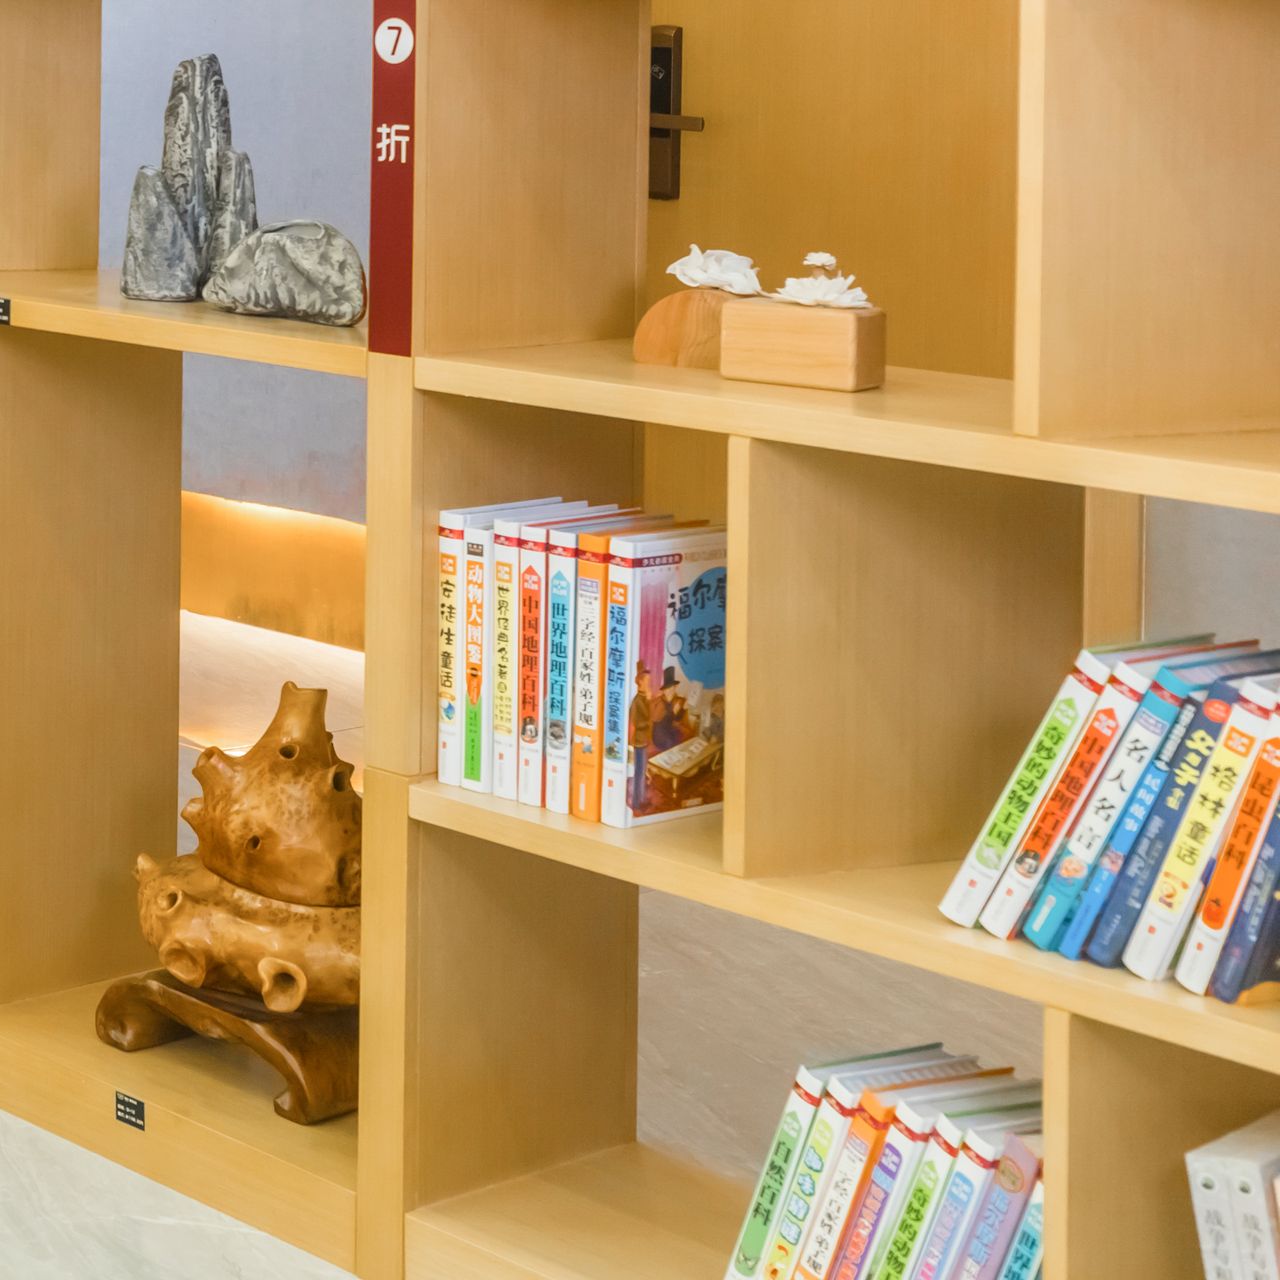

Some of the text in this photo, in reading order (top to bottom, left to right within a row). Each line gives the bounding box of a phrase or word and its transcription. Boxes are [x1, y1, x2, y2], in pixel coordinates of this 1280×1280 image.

[440, 578, 457, 694] 安徒生童话
[466, 564, 484, 671] 动物大图鉴
[522, 595, 540, 713] 中国地理百科
[549, 601, 569, 717] 世界地理百科
[607, 604, 629, 735] 福尔摩斯探案集
[688, 624, 723, 654] 探案
[986, 725, 1065, 847] 奇妙的动物王国
[1027, 736, 1107, 850] 中国地理百科
[1076, 737, 1149, 849] 名人名言
[1176, 761, 1238, 872] 格林童话
[1225, 769, 1278, 875] 昆虫百科
[753, 1140, 792, 1226] 自然百科
